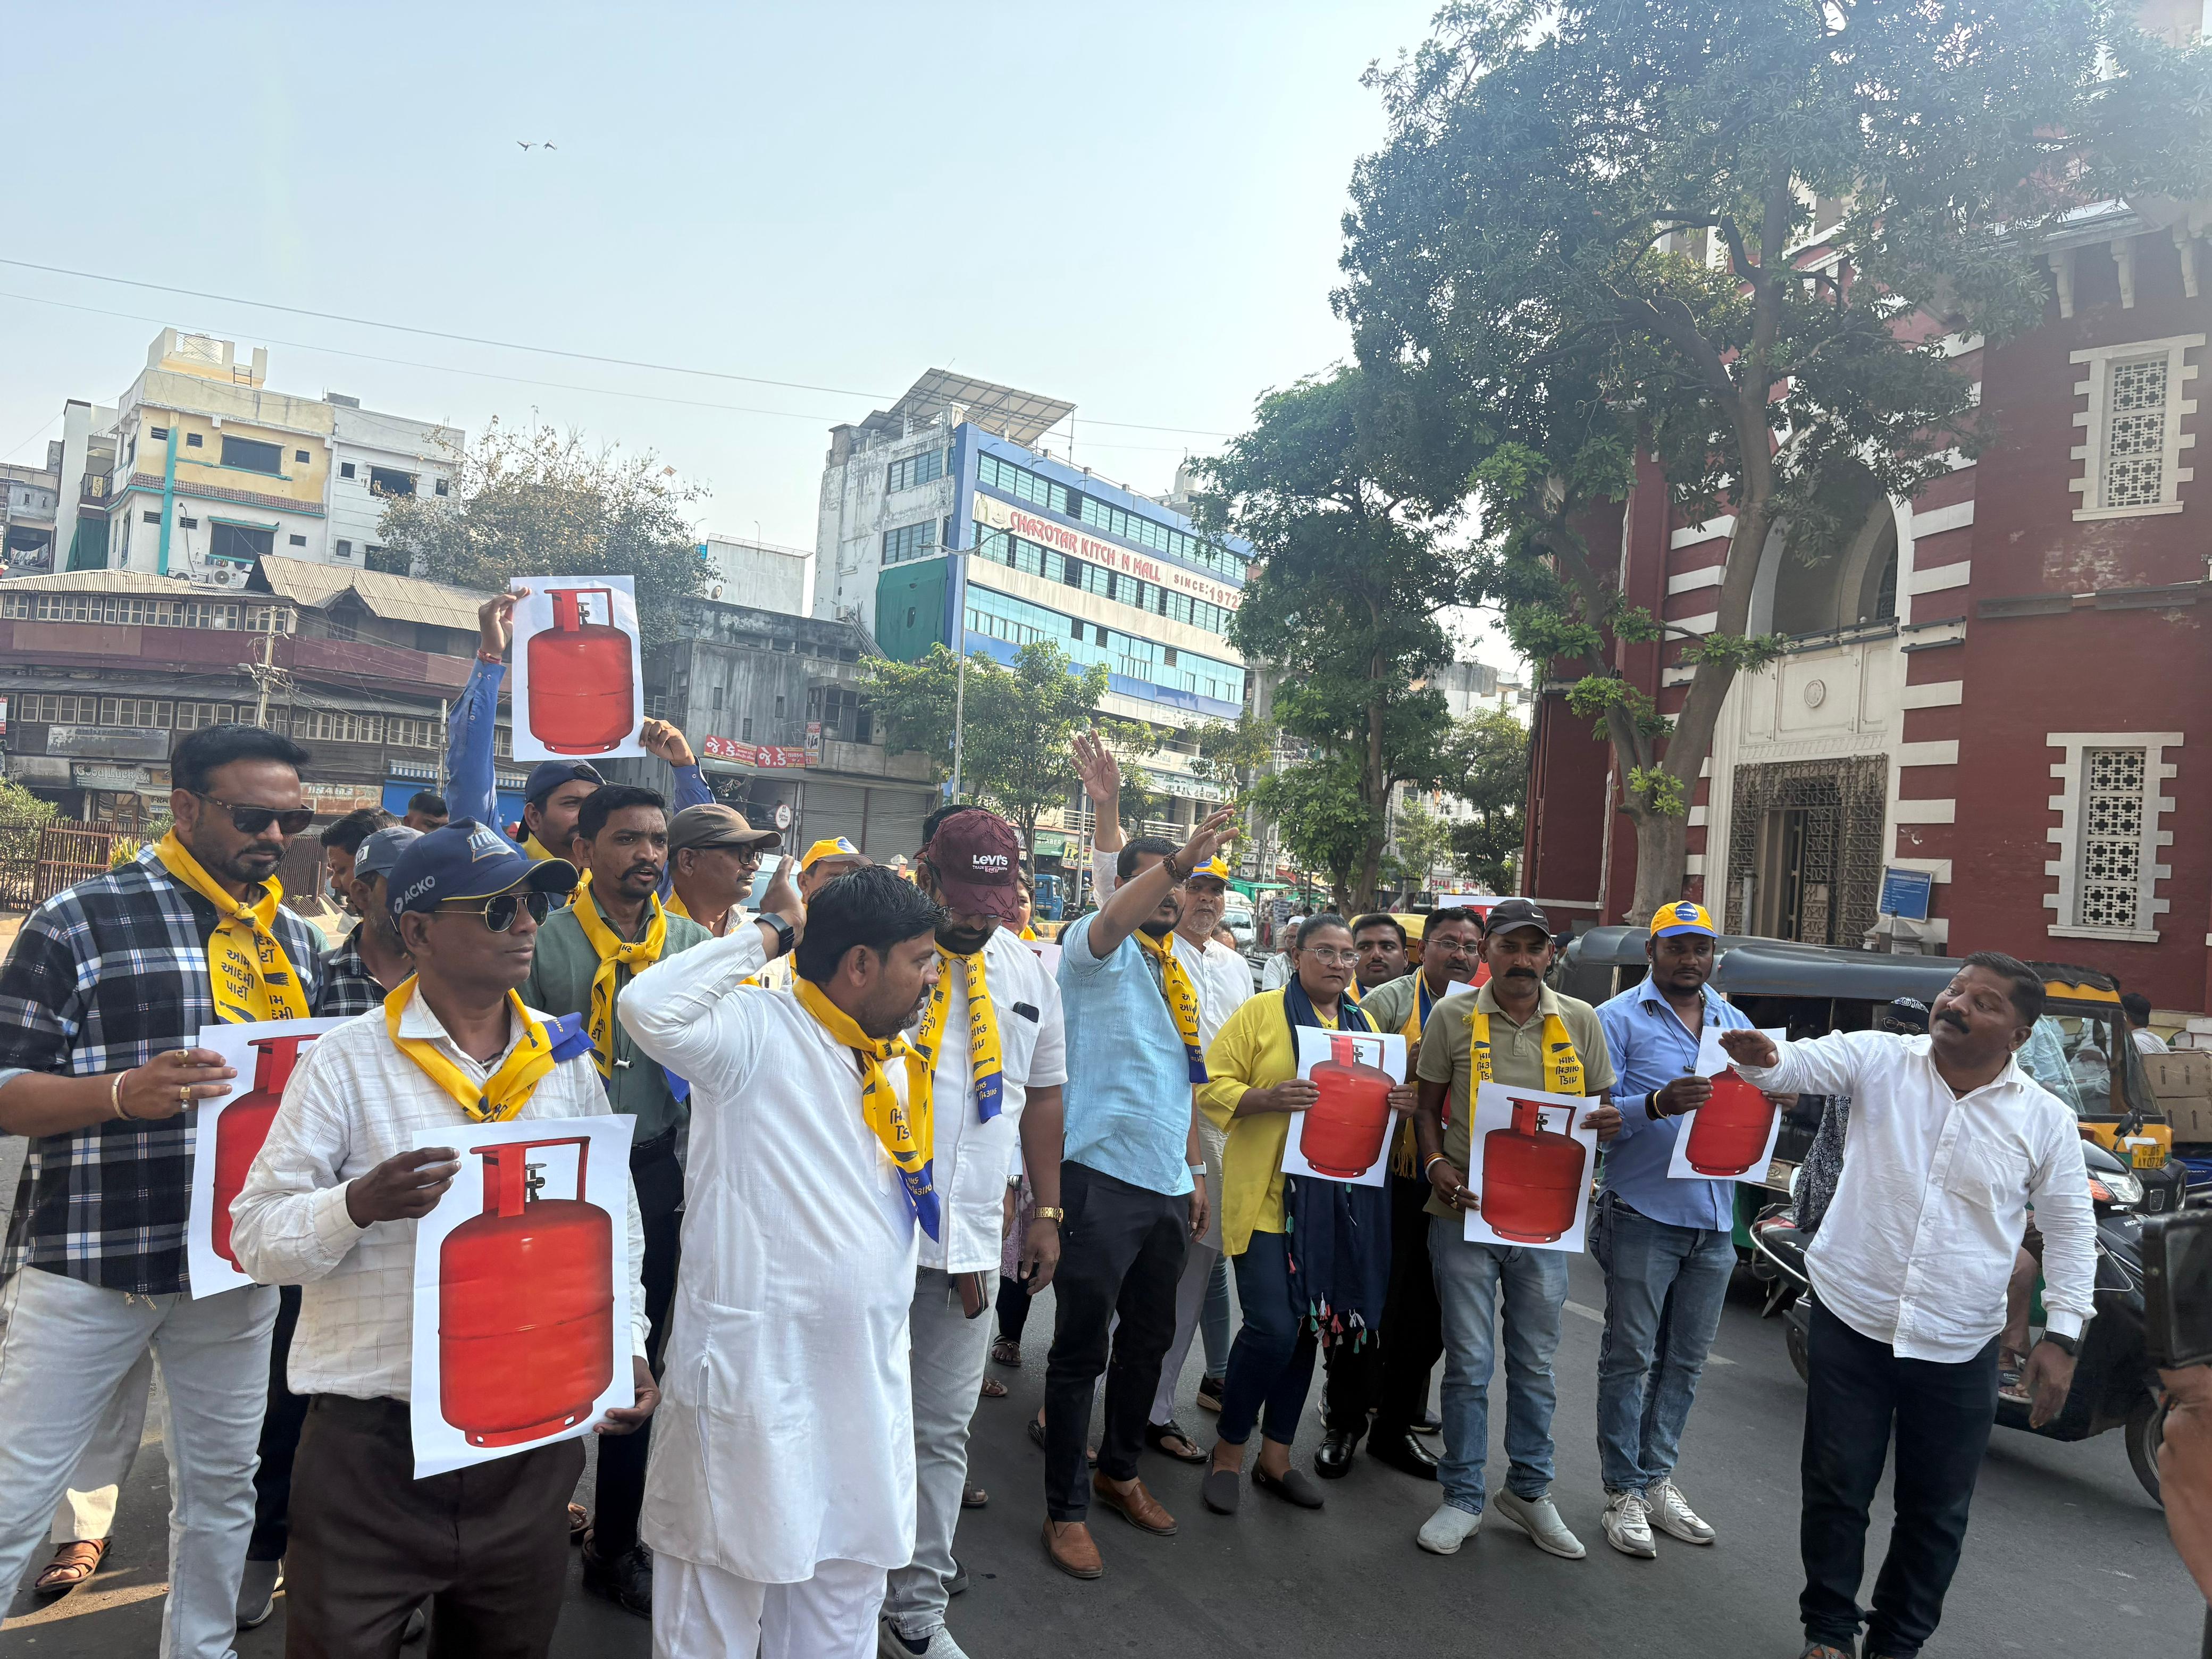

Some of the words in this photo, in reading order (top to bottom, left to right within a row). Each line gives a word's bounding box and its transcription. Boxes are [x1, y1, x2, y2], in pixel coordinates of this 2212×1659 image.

[1010, 512, 1078, 554] CHAROTAR
[1081, 538, 1115, 566] KITCH
[1122, 552, 1130, 570] N
[1133, 559, 1161, 582] MALL
[106, 767, 134, 780] Luck
[404, 876, 435, 904] ACKO
[221, 962, 254, 989] આદમી
